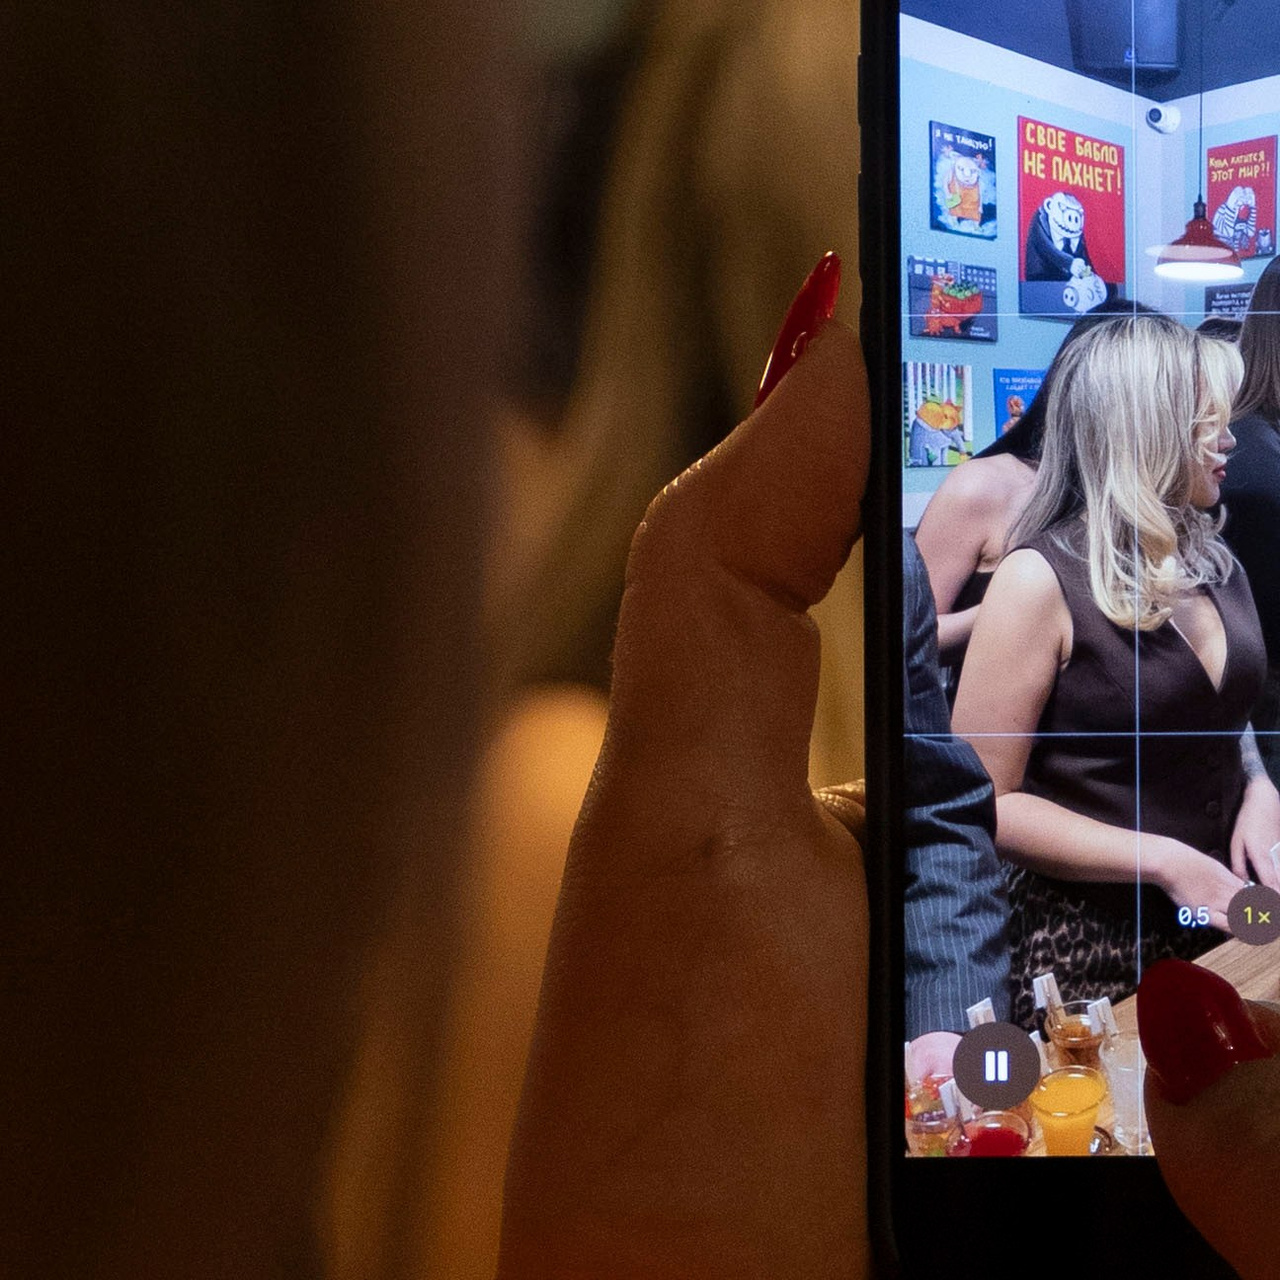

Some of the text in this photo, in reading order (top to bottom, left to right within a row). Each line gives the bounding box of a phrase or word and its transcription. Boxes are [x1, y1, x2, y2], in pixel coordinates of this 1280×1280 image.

[1025, 122, 1119, 166] СВОЕ БАБЛО
[1023, 149, 1122, 196] НЕ ПАХНЕТ!
[1211, 168, 1234, 182] ЭТОТ
[1177, 906, 1211, 928] 0,5
